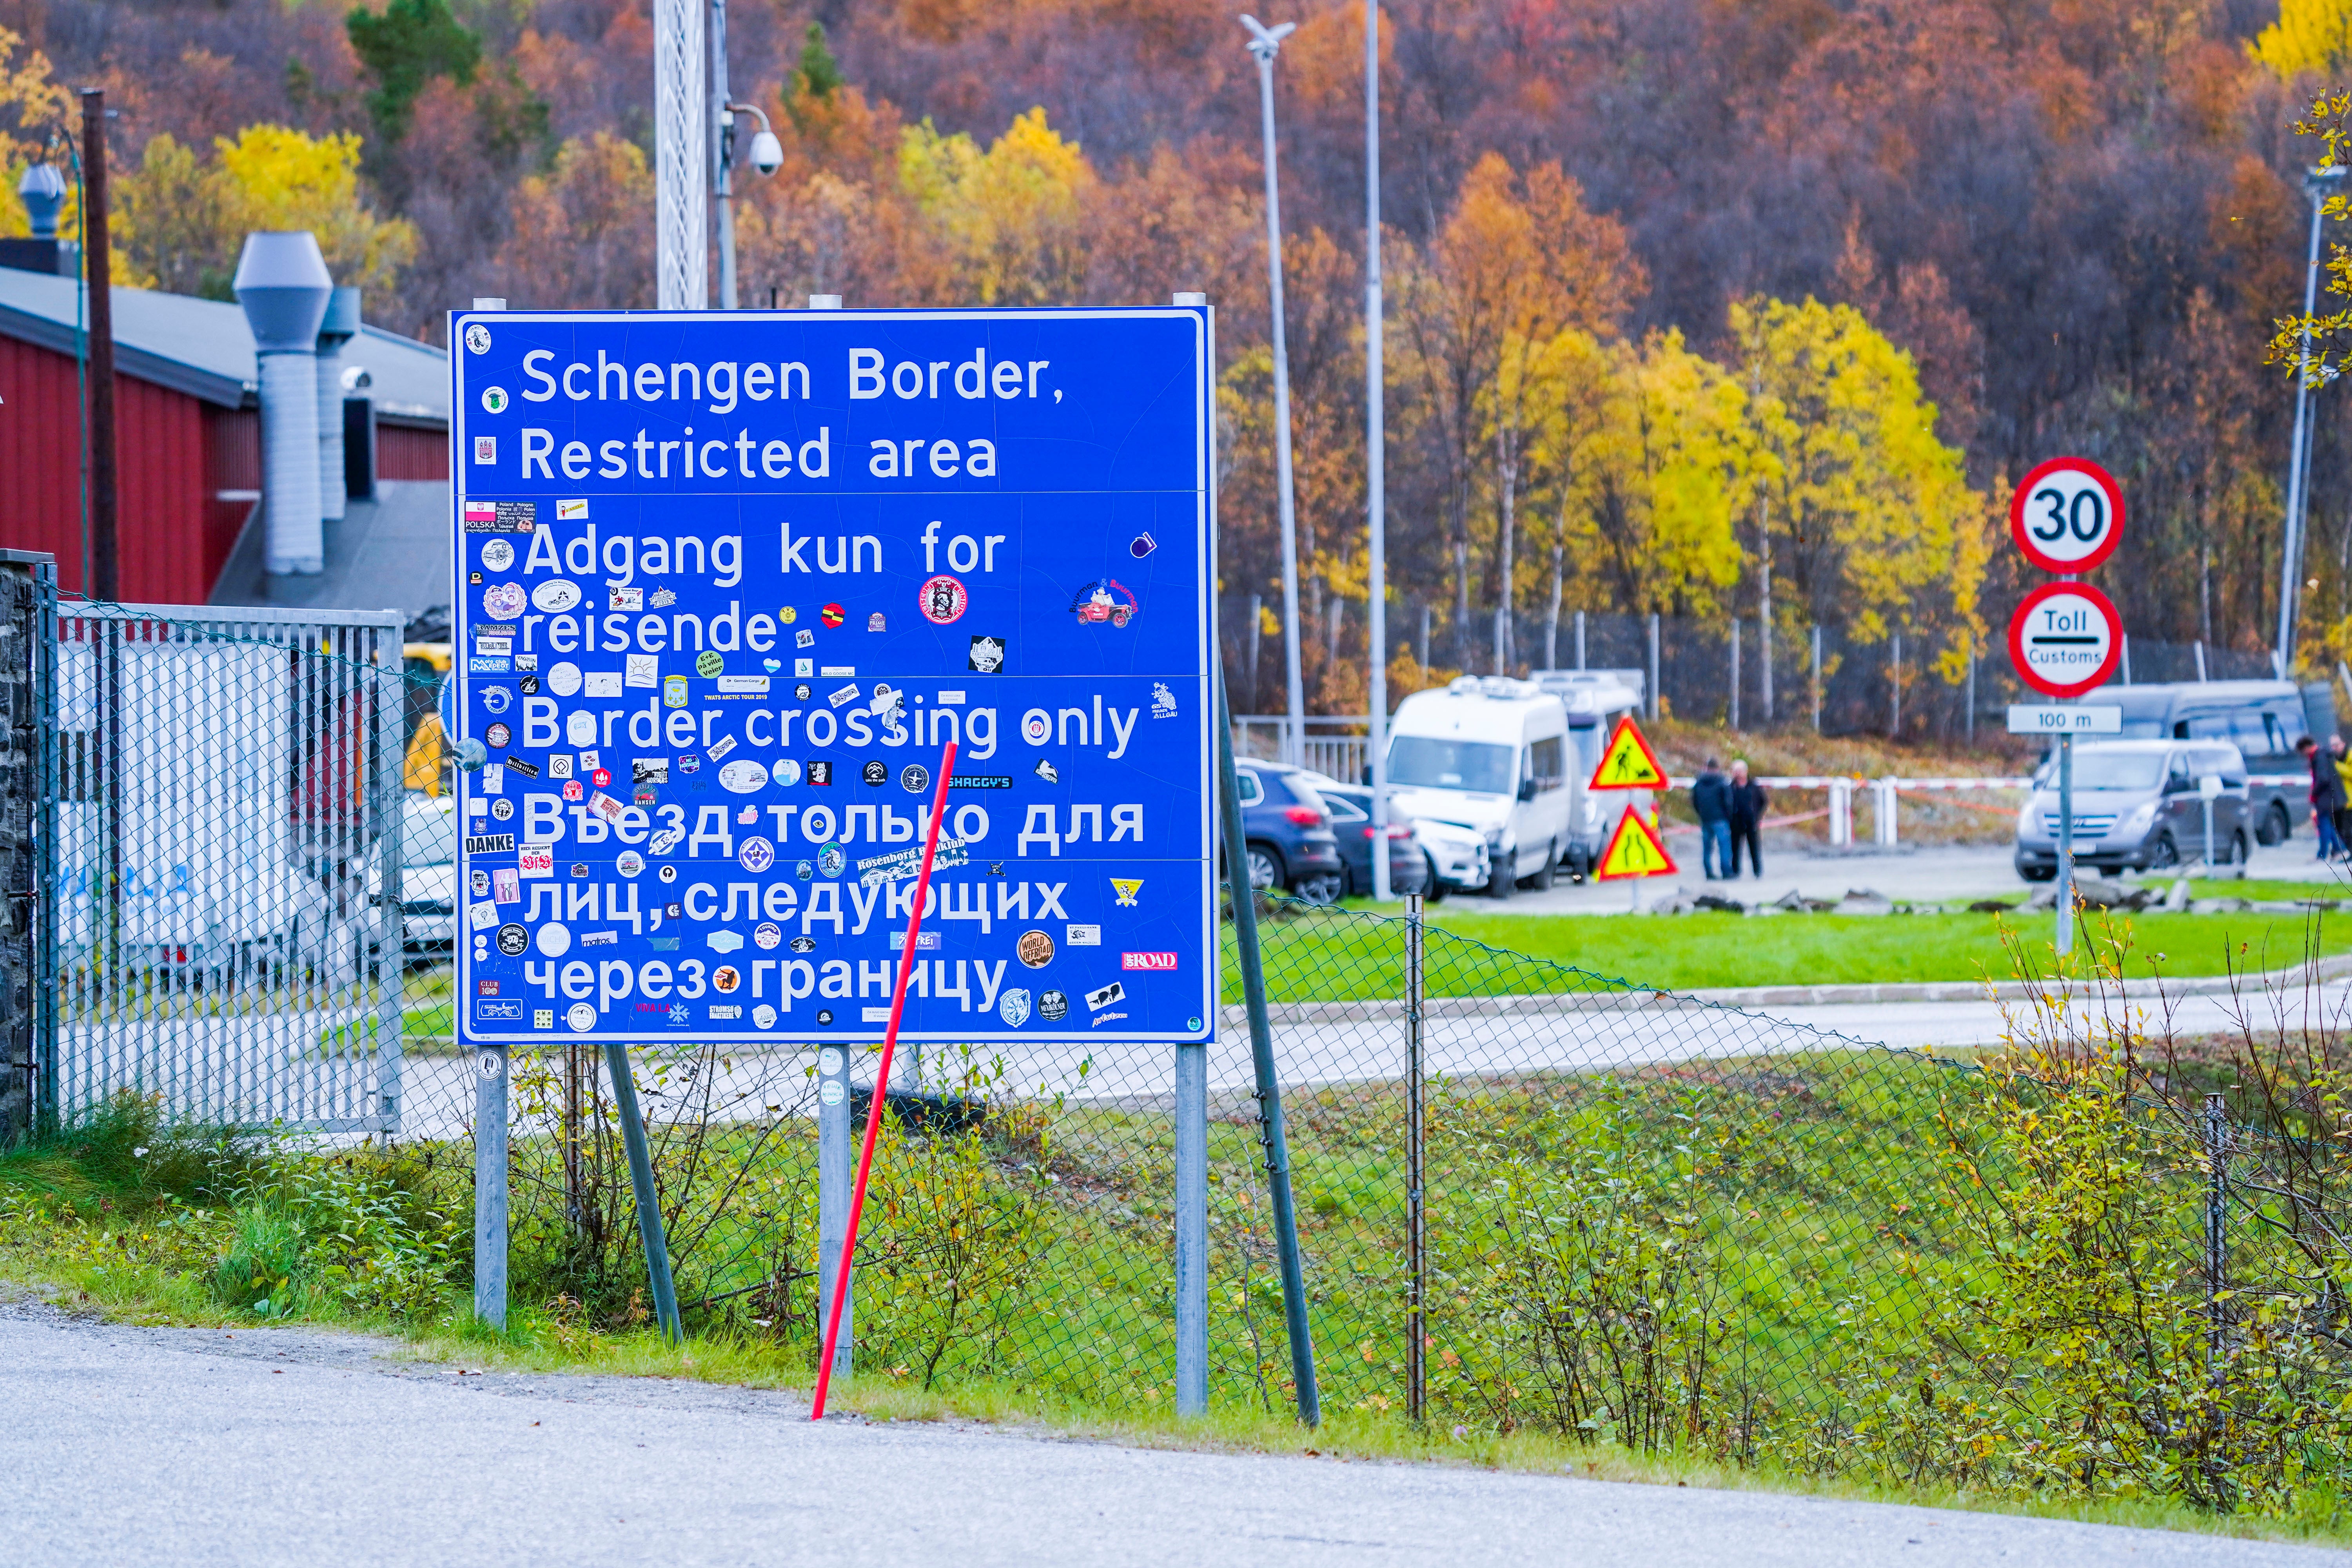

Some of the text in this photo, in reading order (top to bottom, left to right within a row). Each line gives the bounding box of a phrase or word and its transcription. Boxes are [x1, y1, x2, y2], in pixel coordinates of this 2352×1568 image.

[522, 347, 1063, 414] Schengen Border,
[522, 426, 996, 479] Restricted area
[2033, 488, 2104, 542] 30
[523, 521, 1006, 588] Adgang kun for
[921, 583, 966, 615] EISERN UNION
[1069, 581, 1098, 613] Buurman
[1110, 579, 1138, 613] Buurman
[523, 600, 777, 653] reisende
[2044, 610, 2087, 632] Toll
[700, 652, 714, 662] E+E
[707, 658, 721, 666] ville
[2029, 648, 2102, 665] Customs
[703, 665, 722, 676] Veier
[746, 695, 997, 760] crossing
[1021, 694, 1140, 759] only
[2039, 713, 2091, 728] 100 m
[506, 764, 526, 774] MOTORCYCLE
[507, 759, 538, 775] Hillbillies
[634, 784, 656, 793] OVERLAND
[948, 777, 1009, 788] SHAGGY'S
[523, 793, 1143, 857] Въезд только для
[465, 835, 514, 854] DANKE
[857, 849, 916, 870] Rosenborg
[524, 882, 1070, 935] лиц, следующих
[583, 937, 611, 947] matros.
[1022, 936, 1044, 951] WORLD
[1023, 943, 1051, 960] OFFROAD
[1126, 953, 1176, 967] OFF ROAD
[524, 958, 1008, 1013] через границу
[635, 1003, 670, 1012] VIVA LA
